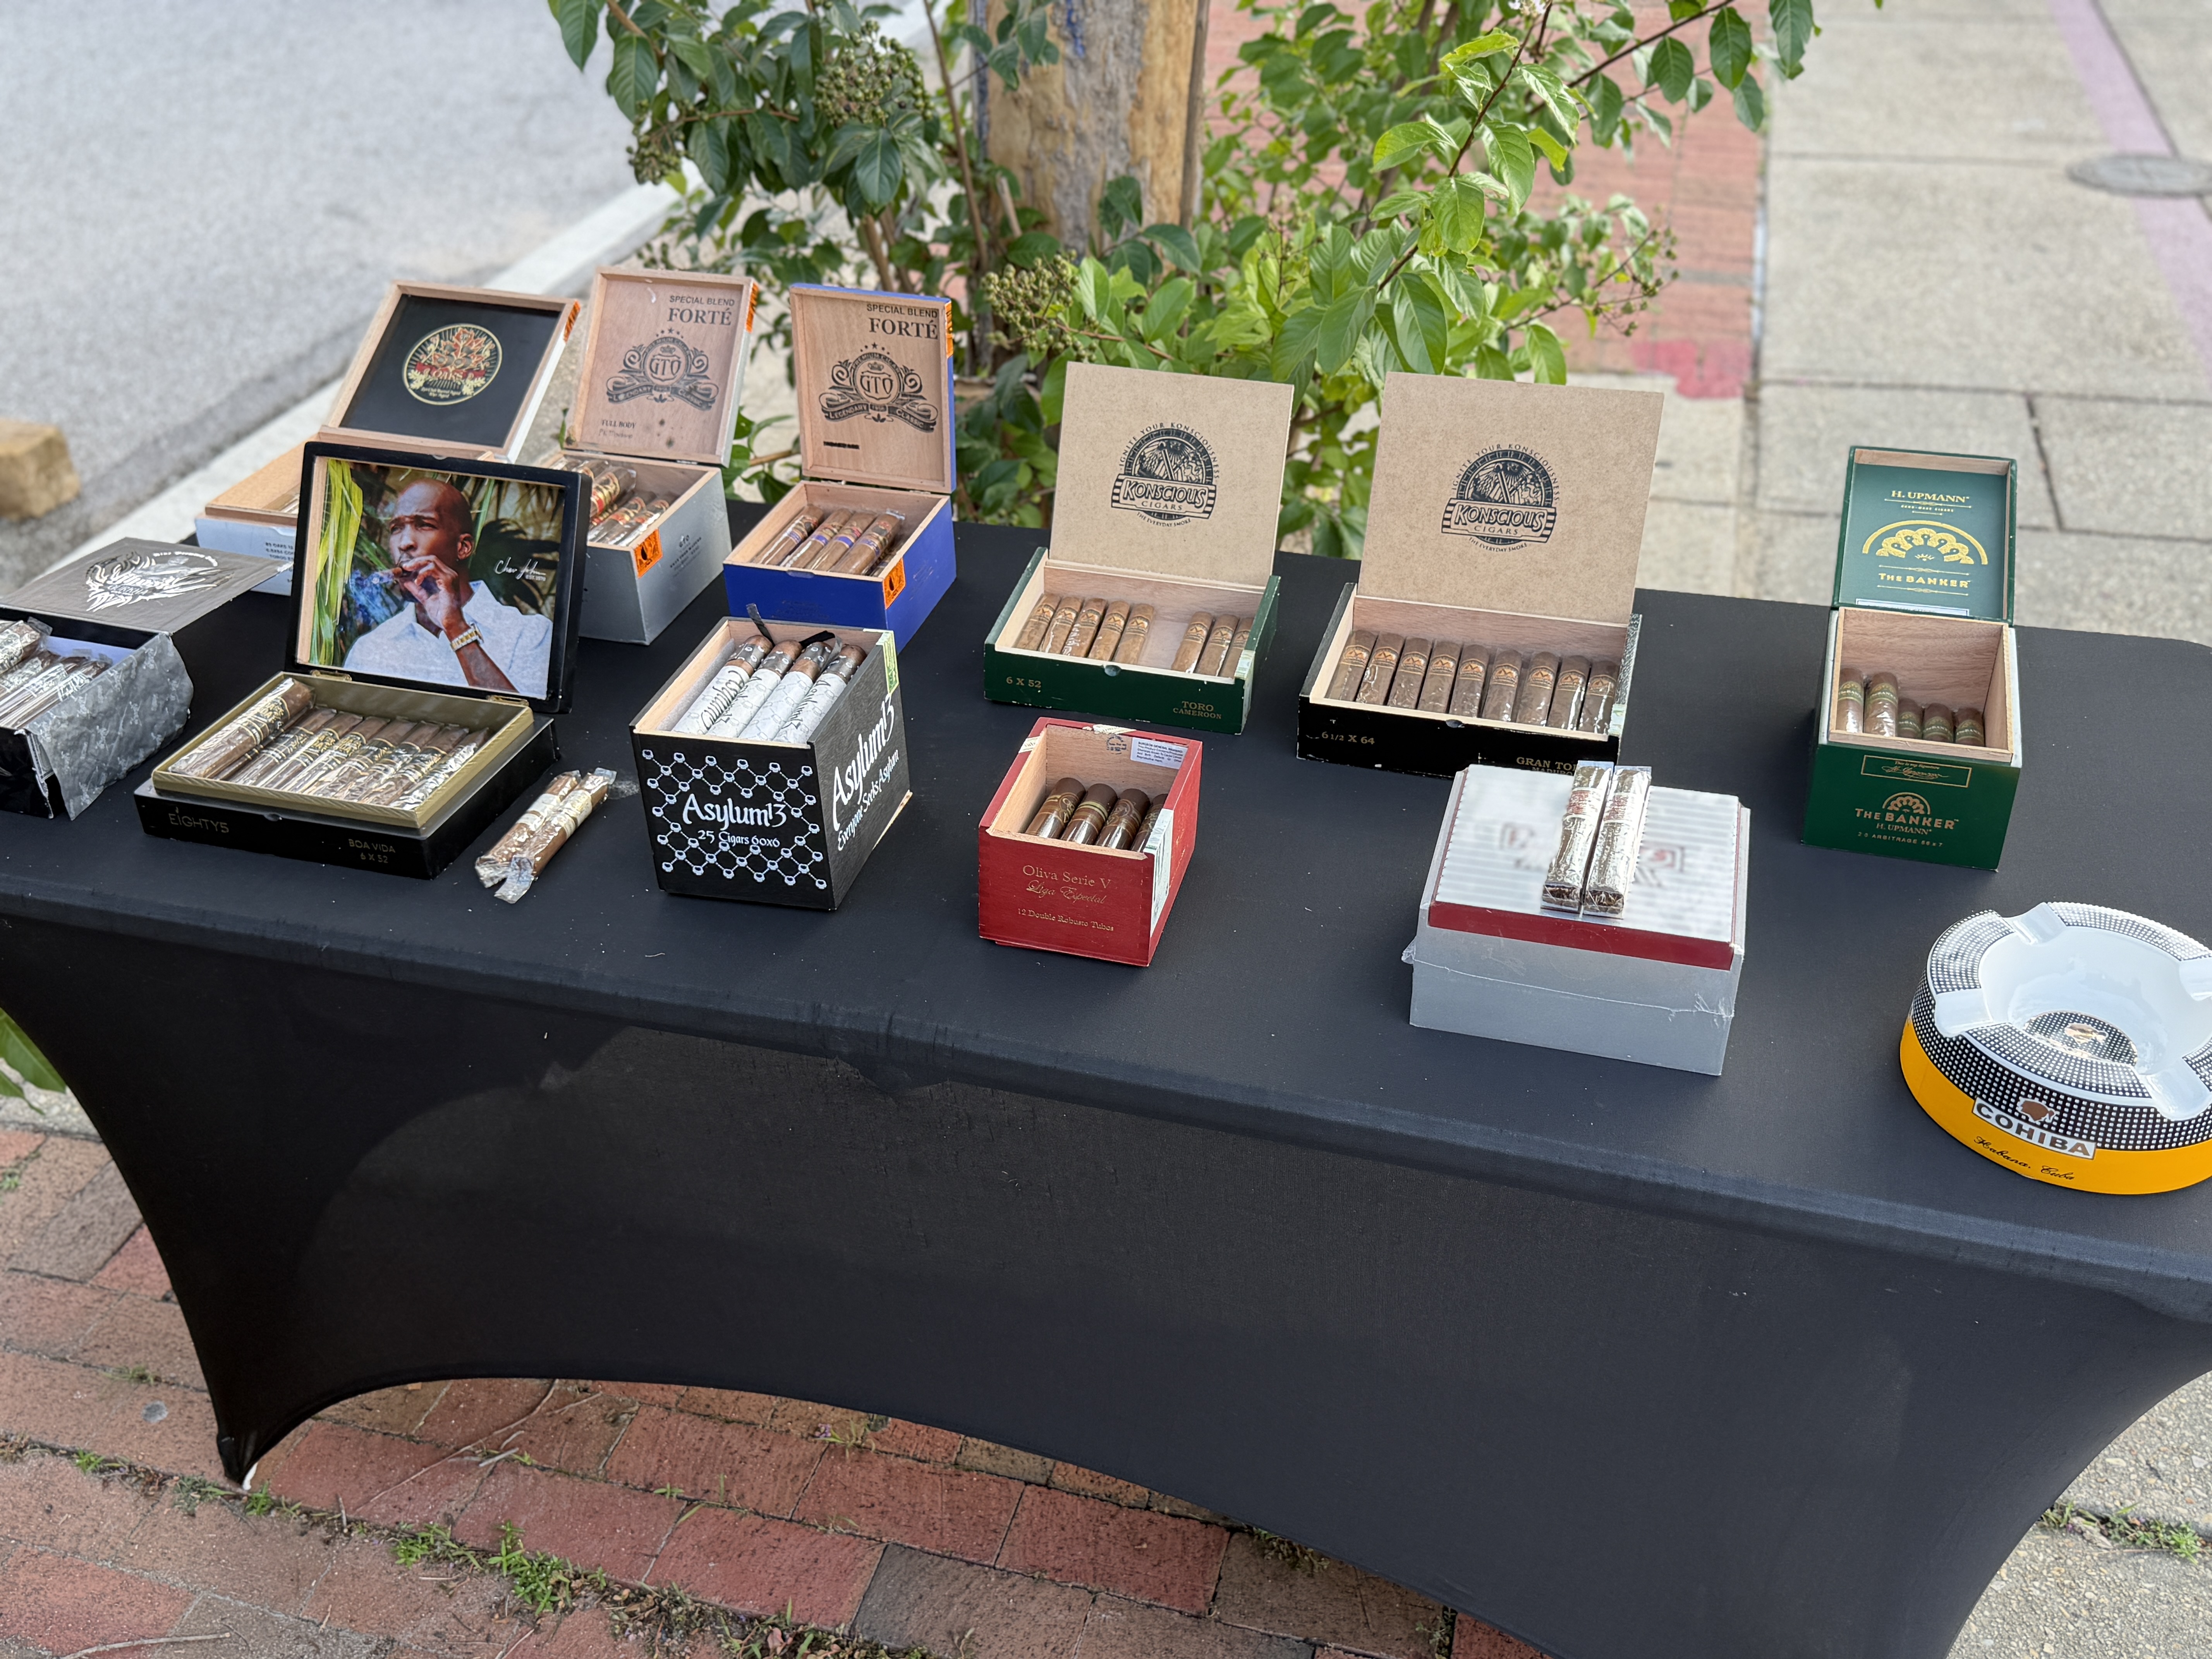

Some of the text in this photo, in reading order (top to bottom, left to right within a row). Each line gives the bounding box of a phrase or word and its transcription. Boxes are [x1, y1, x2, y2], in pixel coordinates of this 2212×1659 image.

[670, 295, 735, 306] SPECIAL BLEND
[667, 307, 732, 326] FORTÉ
[867, 304, 938, 318] SPECIAL BLEND
[869, 318, 938, 340] FORTÉ
[649, 358, 681, 376] GTO
[860, 375, 893, 394] GTO
[829, 404, 867, 419] LEGENDARY
[896, 409, 924, 428] CLASSIC
[1119, 422, 1220, 479] IGNITE YOUR KONSCIOUSNESS
[1451, 443, 1560, 501] IGNITE YOUR KONSCIOUSNESS
[1123, 480, 1207, 508] KONSCIOUS
[1891, 490, 1905, 498] H.
[1141, 500, 1183, 510] CIGARS
[1137, 512, 1192, 527] THE EVERYDAY SMOKE
[1454, 505, 1545, 532] KONSCIOUS
[1474, 525, 1518, 535] CIGARS
[1469, 537, 1528, 552] THE EVERYDAY SMOKE
[1879, 573, 1902, 582] THE
[1006, 677, 1042, 688] 6 X 52
[1173, 708, 1222, 720] CAMEROON
[1182, 701, 1214, 712] TORO
[1347, 734, 1358, 743] X
[1360, 735, 1375, 745] 64
[833, 692, 895, 831] Asylum13
[1516, 757, 1551, 768] GRAN
[838, 749, 899, 851] Everyone Seeks Asylum
[682, 793, 787, 831] Asylum13
[1855, 808, 1881, 820] THE
[168, 808, 230, 833] EIGHTY5
[348, 839, 396, 853] BOA VIDA
[697, 830, 780, 848] 25 Cigars 60x6
[1872, 834, 1917, 844] ARBITRAGE
[361, 852, 366, 860] 6
[378, 854, 388, 863] 52
[1023, 864, 1112, 889] Oliva Serie V
[1026, 880, 1107, 904] Liga Especial
[1028, 909, 1056, 921] Double
[1058, 915, 1089, 927] Robusto
[1977, 1103, 2090, 1156] COHIBA
[2040, 1165, 2075, 1180] Cuba
